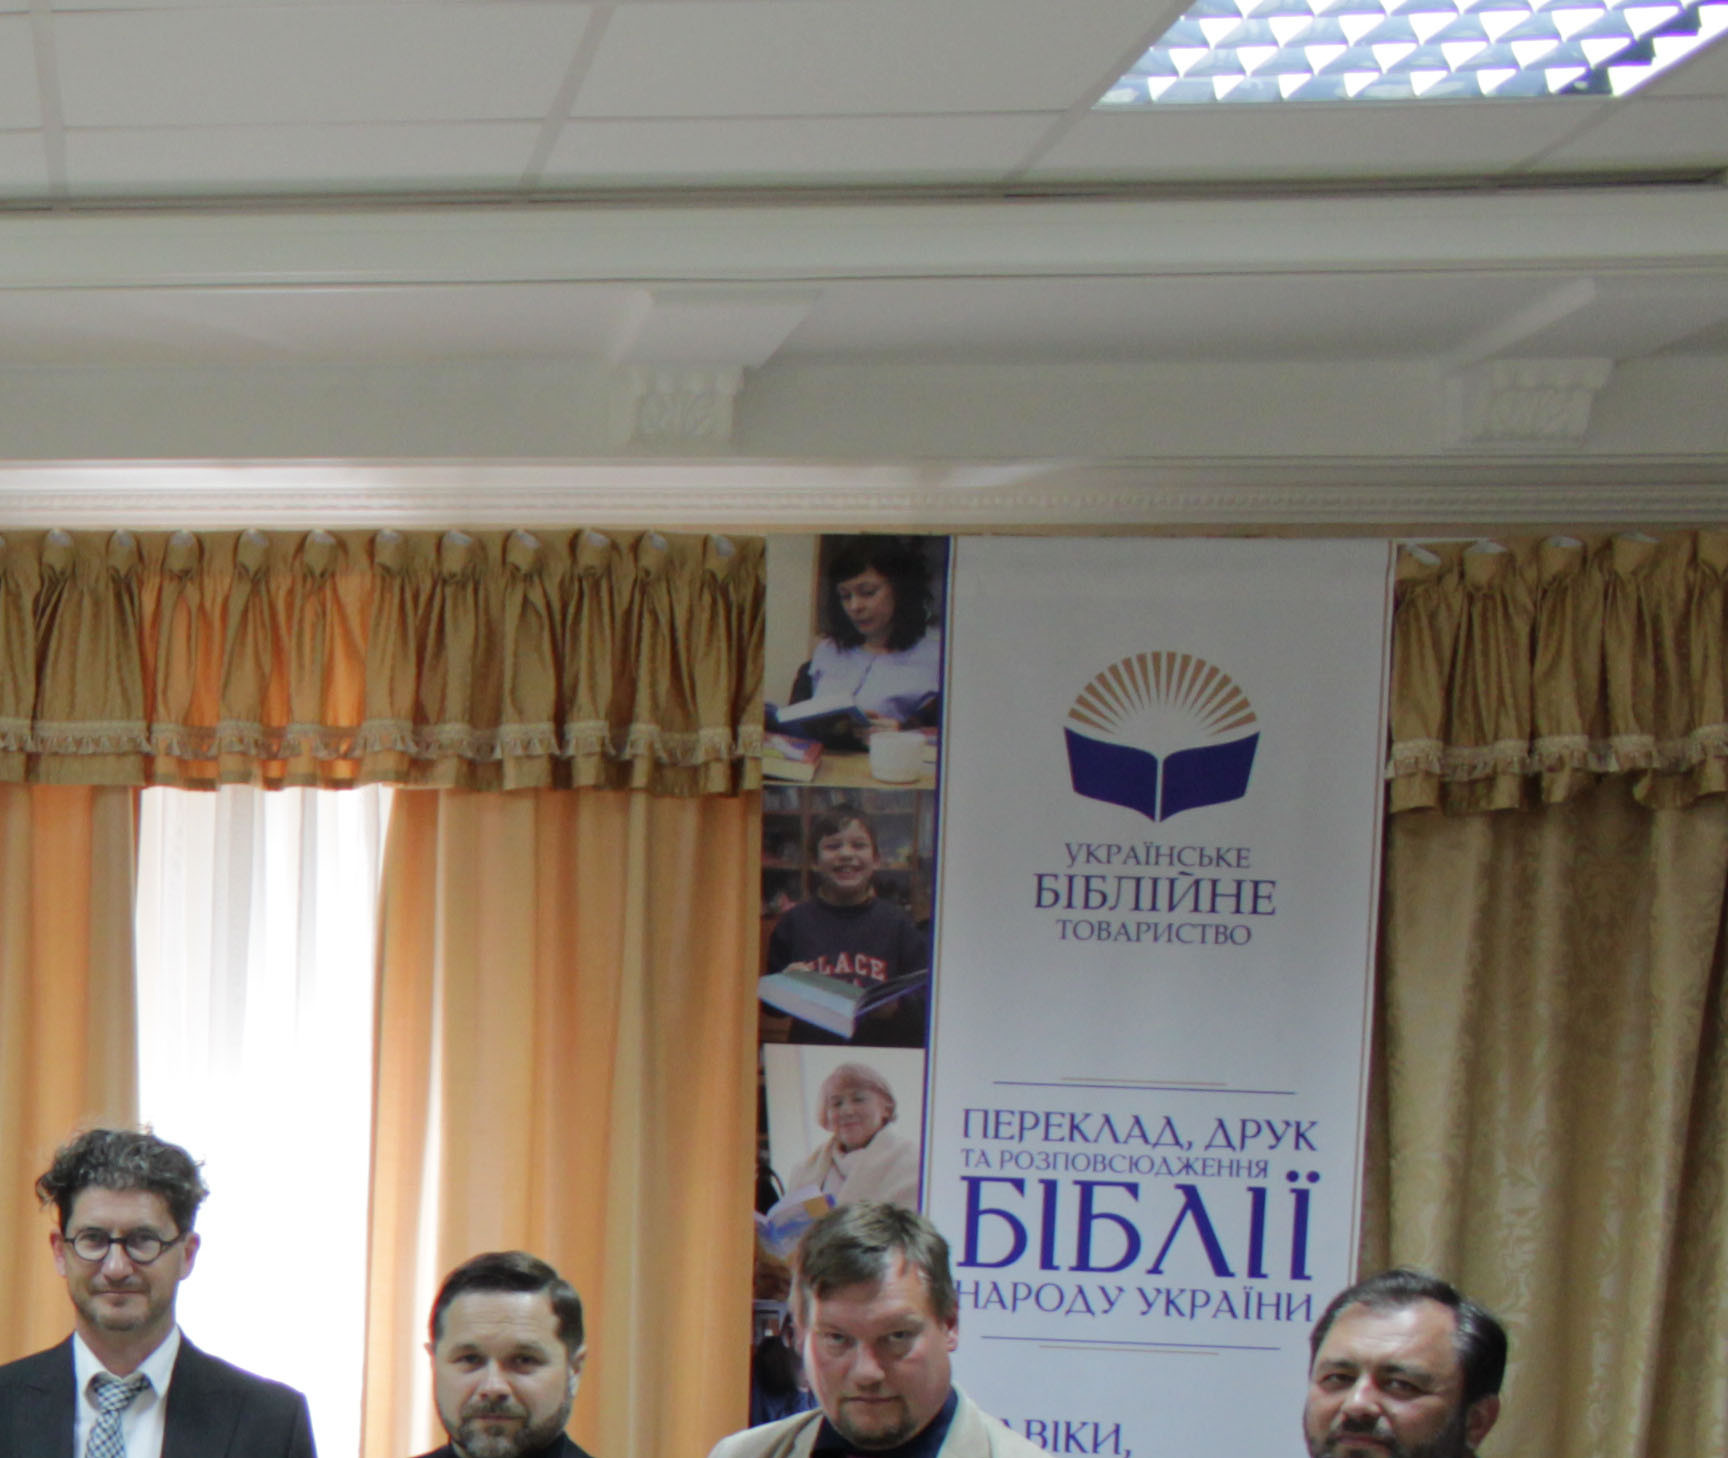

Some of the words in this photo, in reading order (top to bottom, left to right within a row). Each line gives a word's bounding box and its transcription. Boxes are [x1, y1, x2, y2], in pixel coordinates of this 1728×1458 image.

[1064, 841, 1252, 869] УКРАЇНСЬКЕ
[1033, 870, 1278, 916] БІБЛІЙНЕ
[1055, 918, 1253, 946] ТОВАРИСТВО
[813, 951, 888, 982] LACE
[963, 1108, 1194, 1151] ПЕРЕКЛАД,
[1204, 1117, 1319, 1153] ДРУК
[960, 1148, 992, 1169] ТА
[999, 1149, 1269, 1179] РОЗПОВСЮДЖЕННЯ
[956, 1170, 1320, 1281] БІБЛІЇ
[956, 1279, 1126, 1318] НАРОДУ
[1135, 1286, 1314, 1323] УКРАЇНИ
